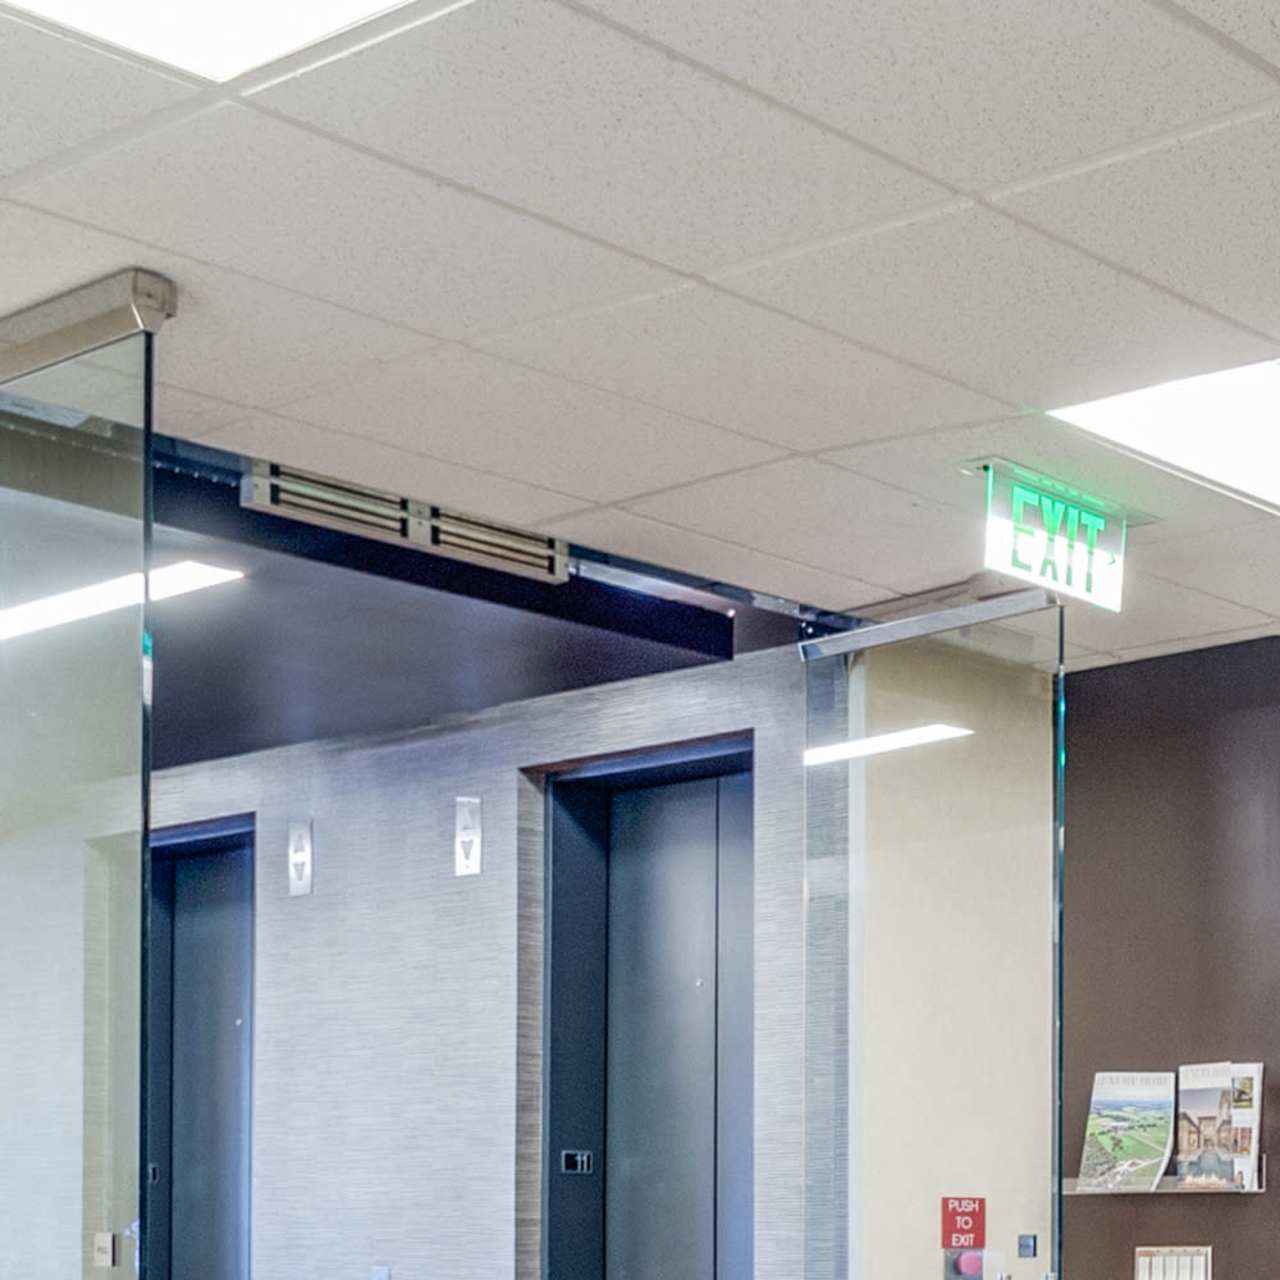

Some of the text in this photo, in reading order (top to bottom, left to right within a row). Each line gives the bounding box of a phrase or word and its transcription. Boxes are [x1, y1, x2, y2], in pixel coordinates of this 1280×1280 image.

[1011, 484, 1105, 593] EXIT
[948, 1200, 979, 1213] PUSH
[955, 1216, 973, 1230] TO
[952, 1233, 975, 1247] EXIT
